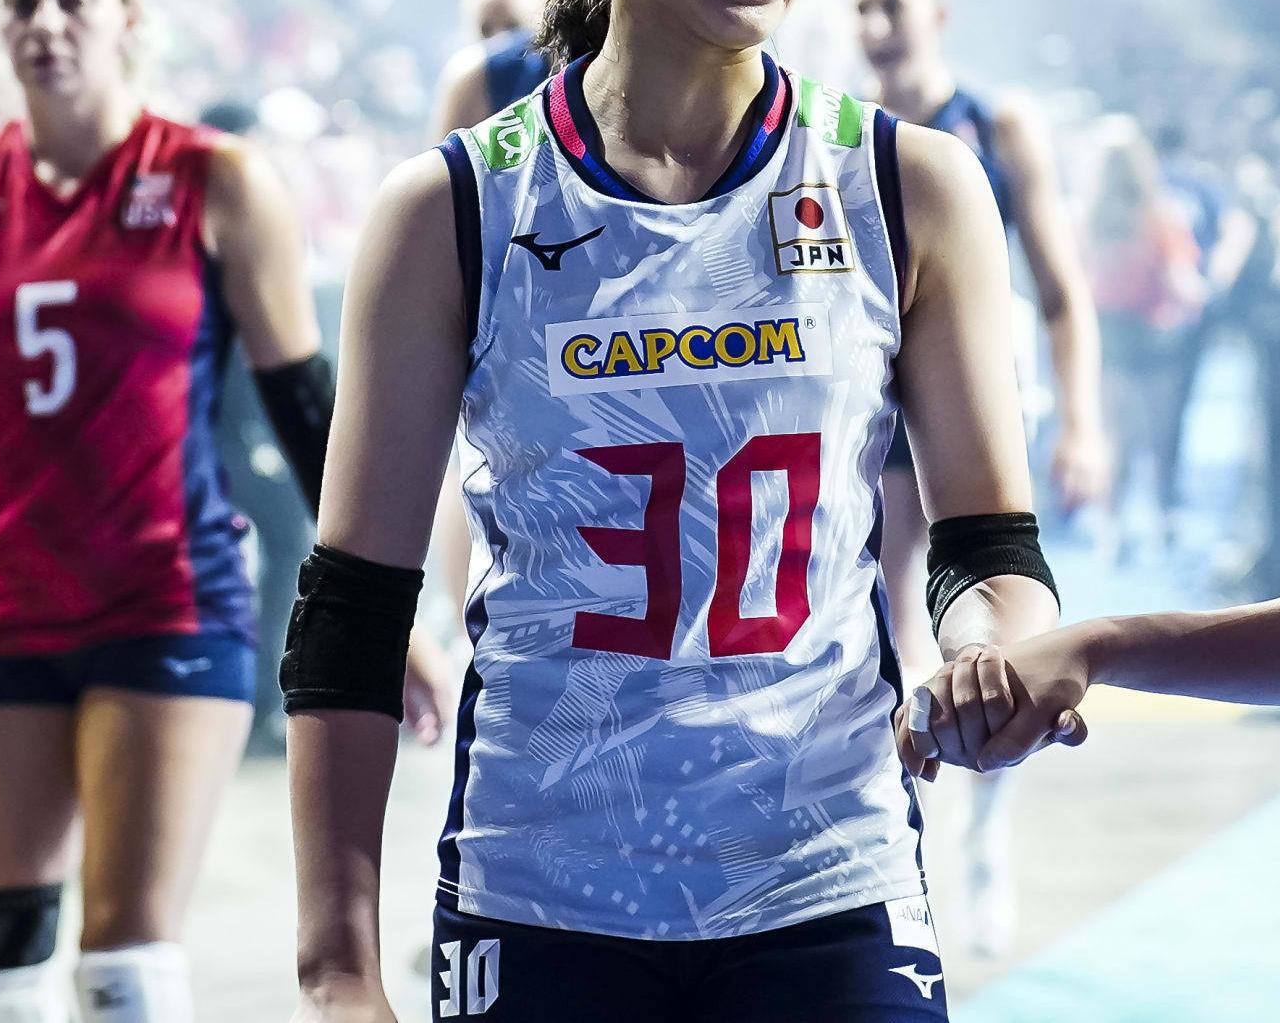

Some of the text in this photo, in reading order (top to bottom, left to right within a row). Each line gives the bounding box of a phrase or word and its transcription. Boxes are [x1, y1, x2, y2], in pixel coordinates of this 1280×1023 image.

[789, 244, 845, 267] JPN
[15, 280, 79, 416] 5
[572, 432, 822, 661] 30
[438, 938, 501, 1018] 30
